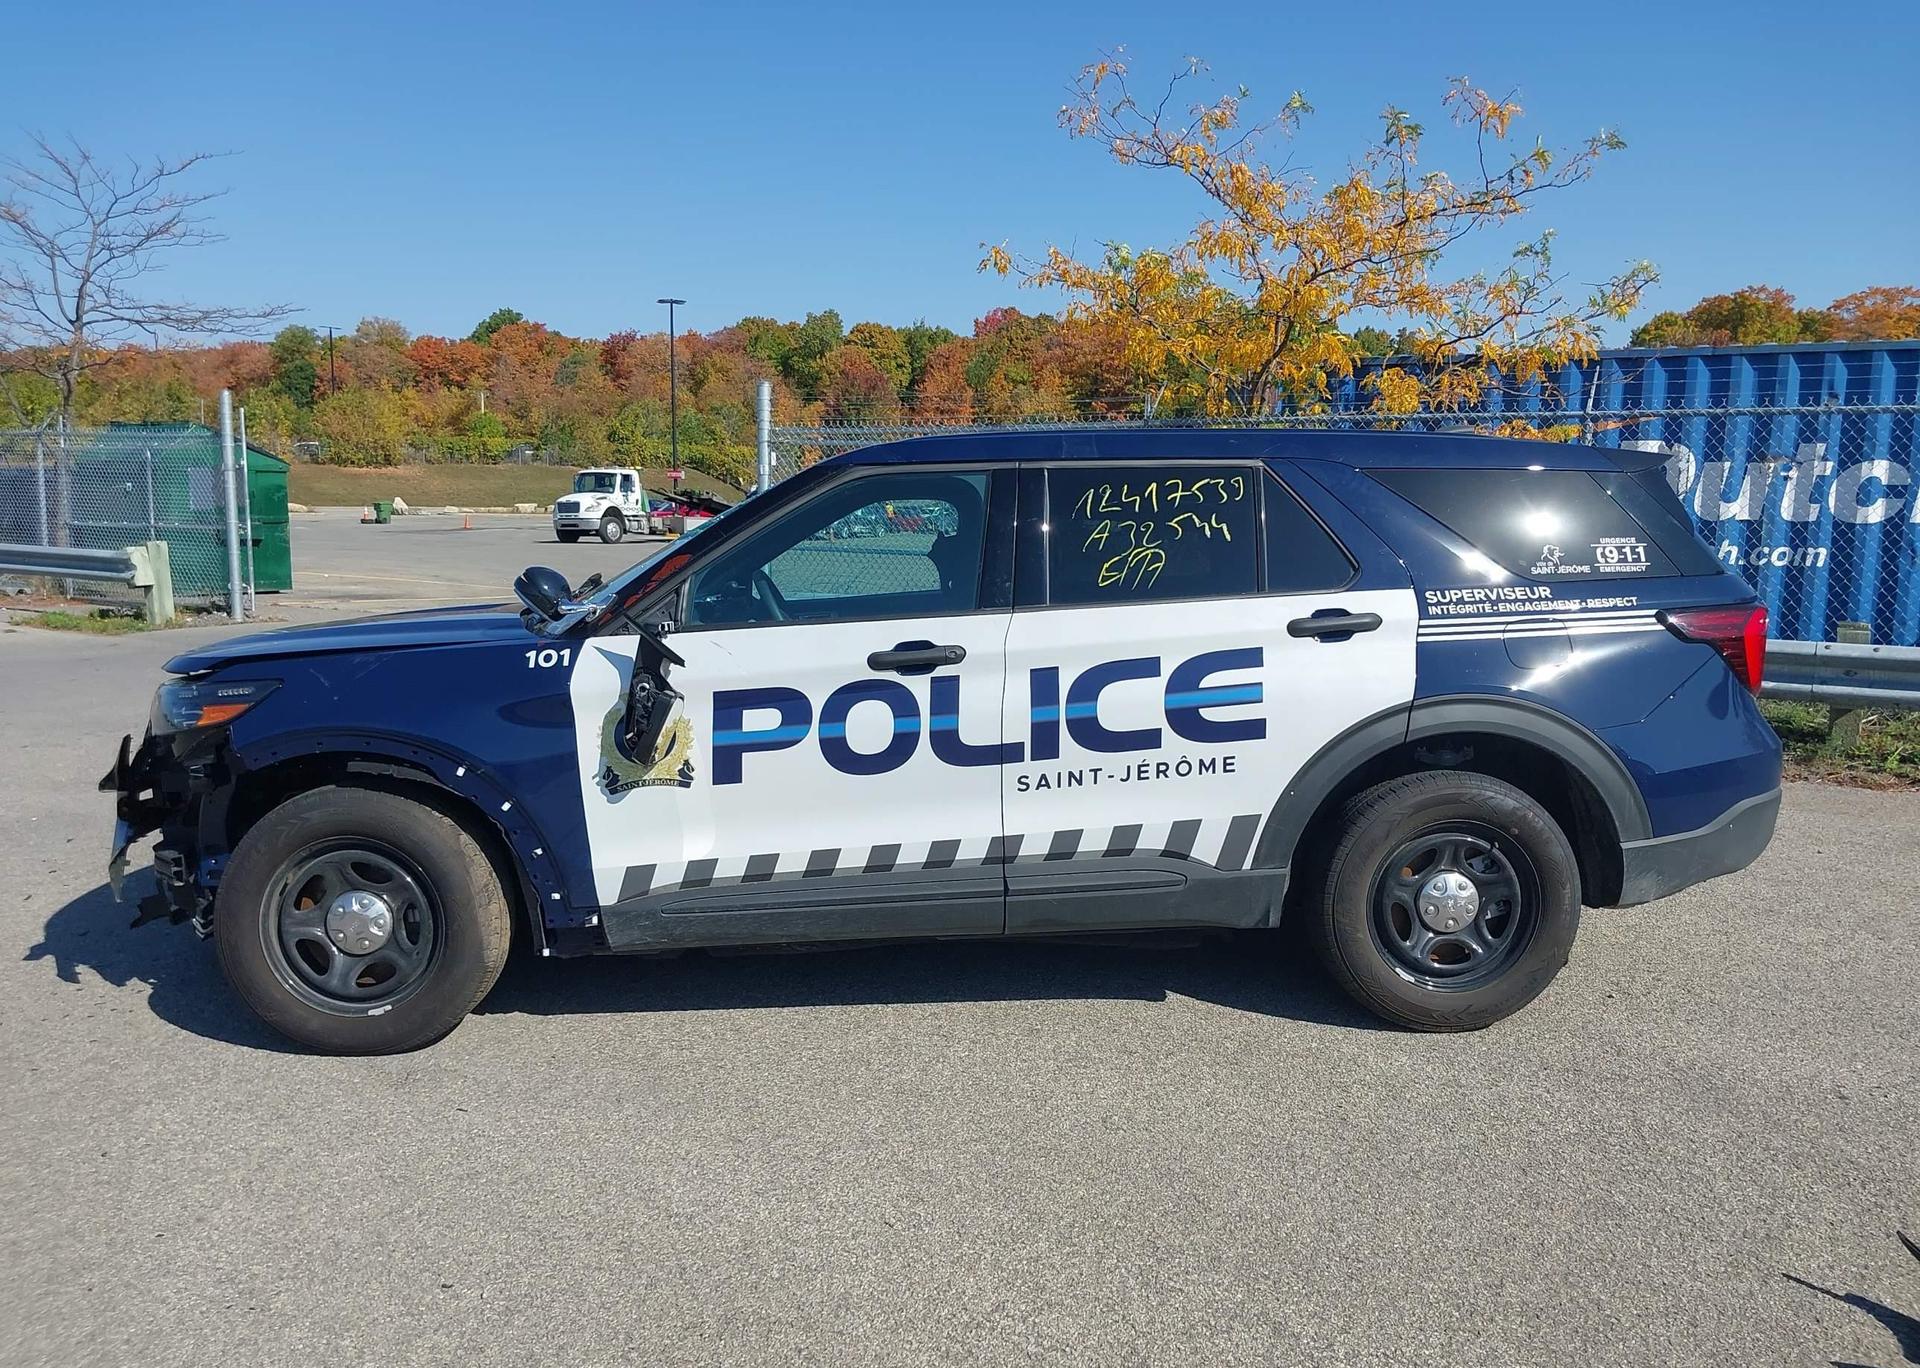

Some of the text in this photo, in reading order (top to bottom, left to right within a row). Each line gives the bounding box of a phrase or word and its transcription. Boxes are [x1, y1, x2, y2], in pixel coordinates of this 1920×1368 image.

[1620, 440, 1920, 524] utc
[1599, 565, 1646, 573] EMERGENCY
[1425, 586, 1552, 604] SUPERVISEUR
[525, 648, 571, 668] 101
[711, 647, 1267, 787] POLICE
[1016, 755, 1237, 792] SAINT-JÉRÔME
